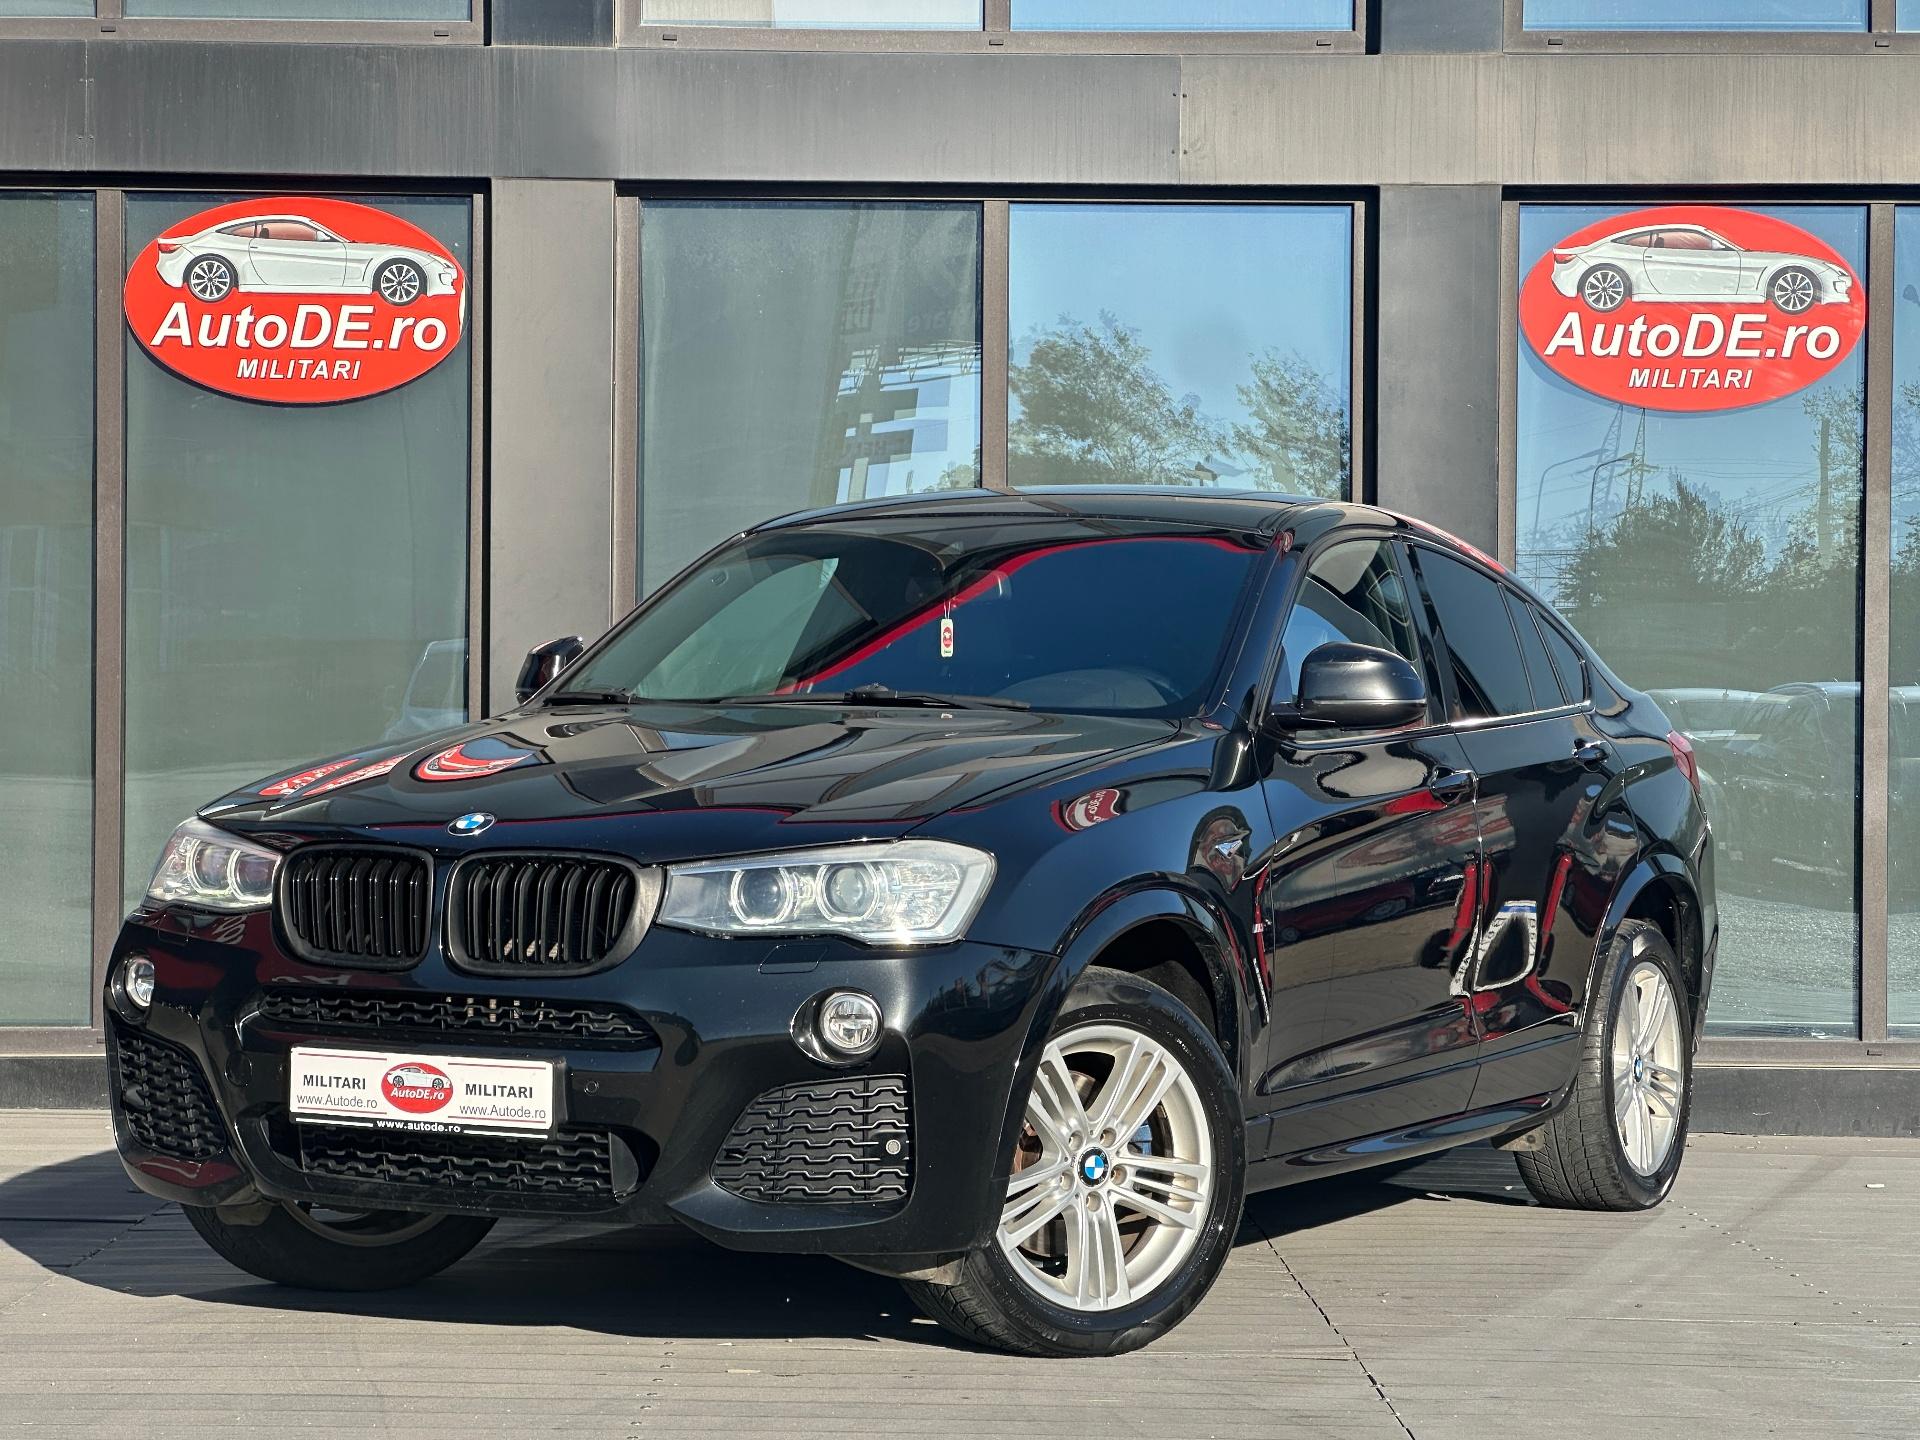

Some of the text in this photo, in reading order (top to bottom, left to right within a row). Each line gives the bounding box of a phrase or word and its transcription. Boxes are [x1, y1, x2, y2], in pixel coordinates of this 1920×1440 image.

[150, 302, 447, 351] AutoDE.ro
[1544, 312, 1840, 359] AutoDE.ro
[236, 358, 361, 380] MILITARI
[1628, 368, 1753, 389] MILITARI
[302, 1074, 366, 1090] MILITARI
[465, 1083, 533, 1099] MILITARI
[296, 1092, 378, 1109] www.Autode.ro
[459, 1104, 546, 1119] www.Autode.ro
[376, 1120, 461, 1133] www.autode.ro
